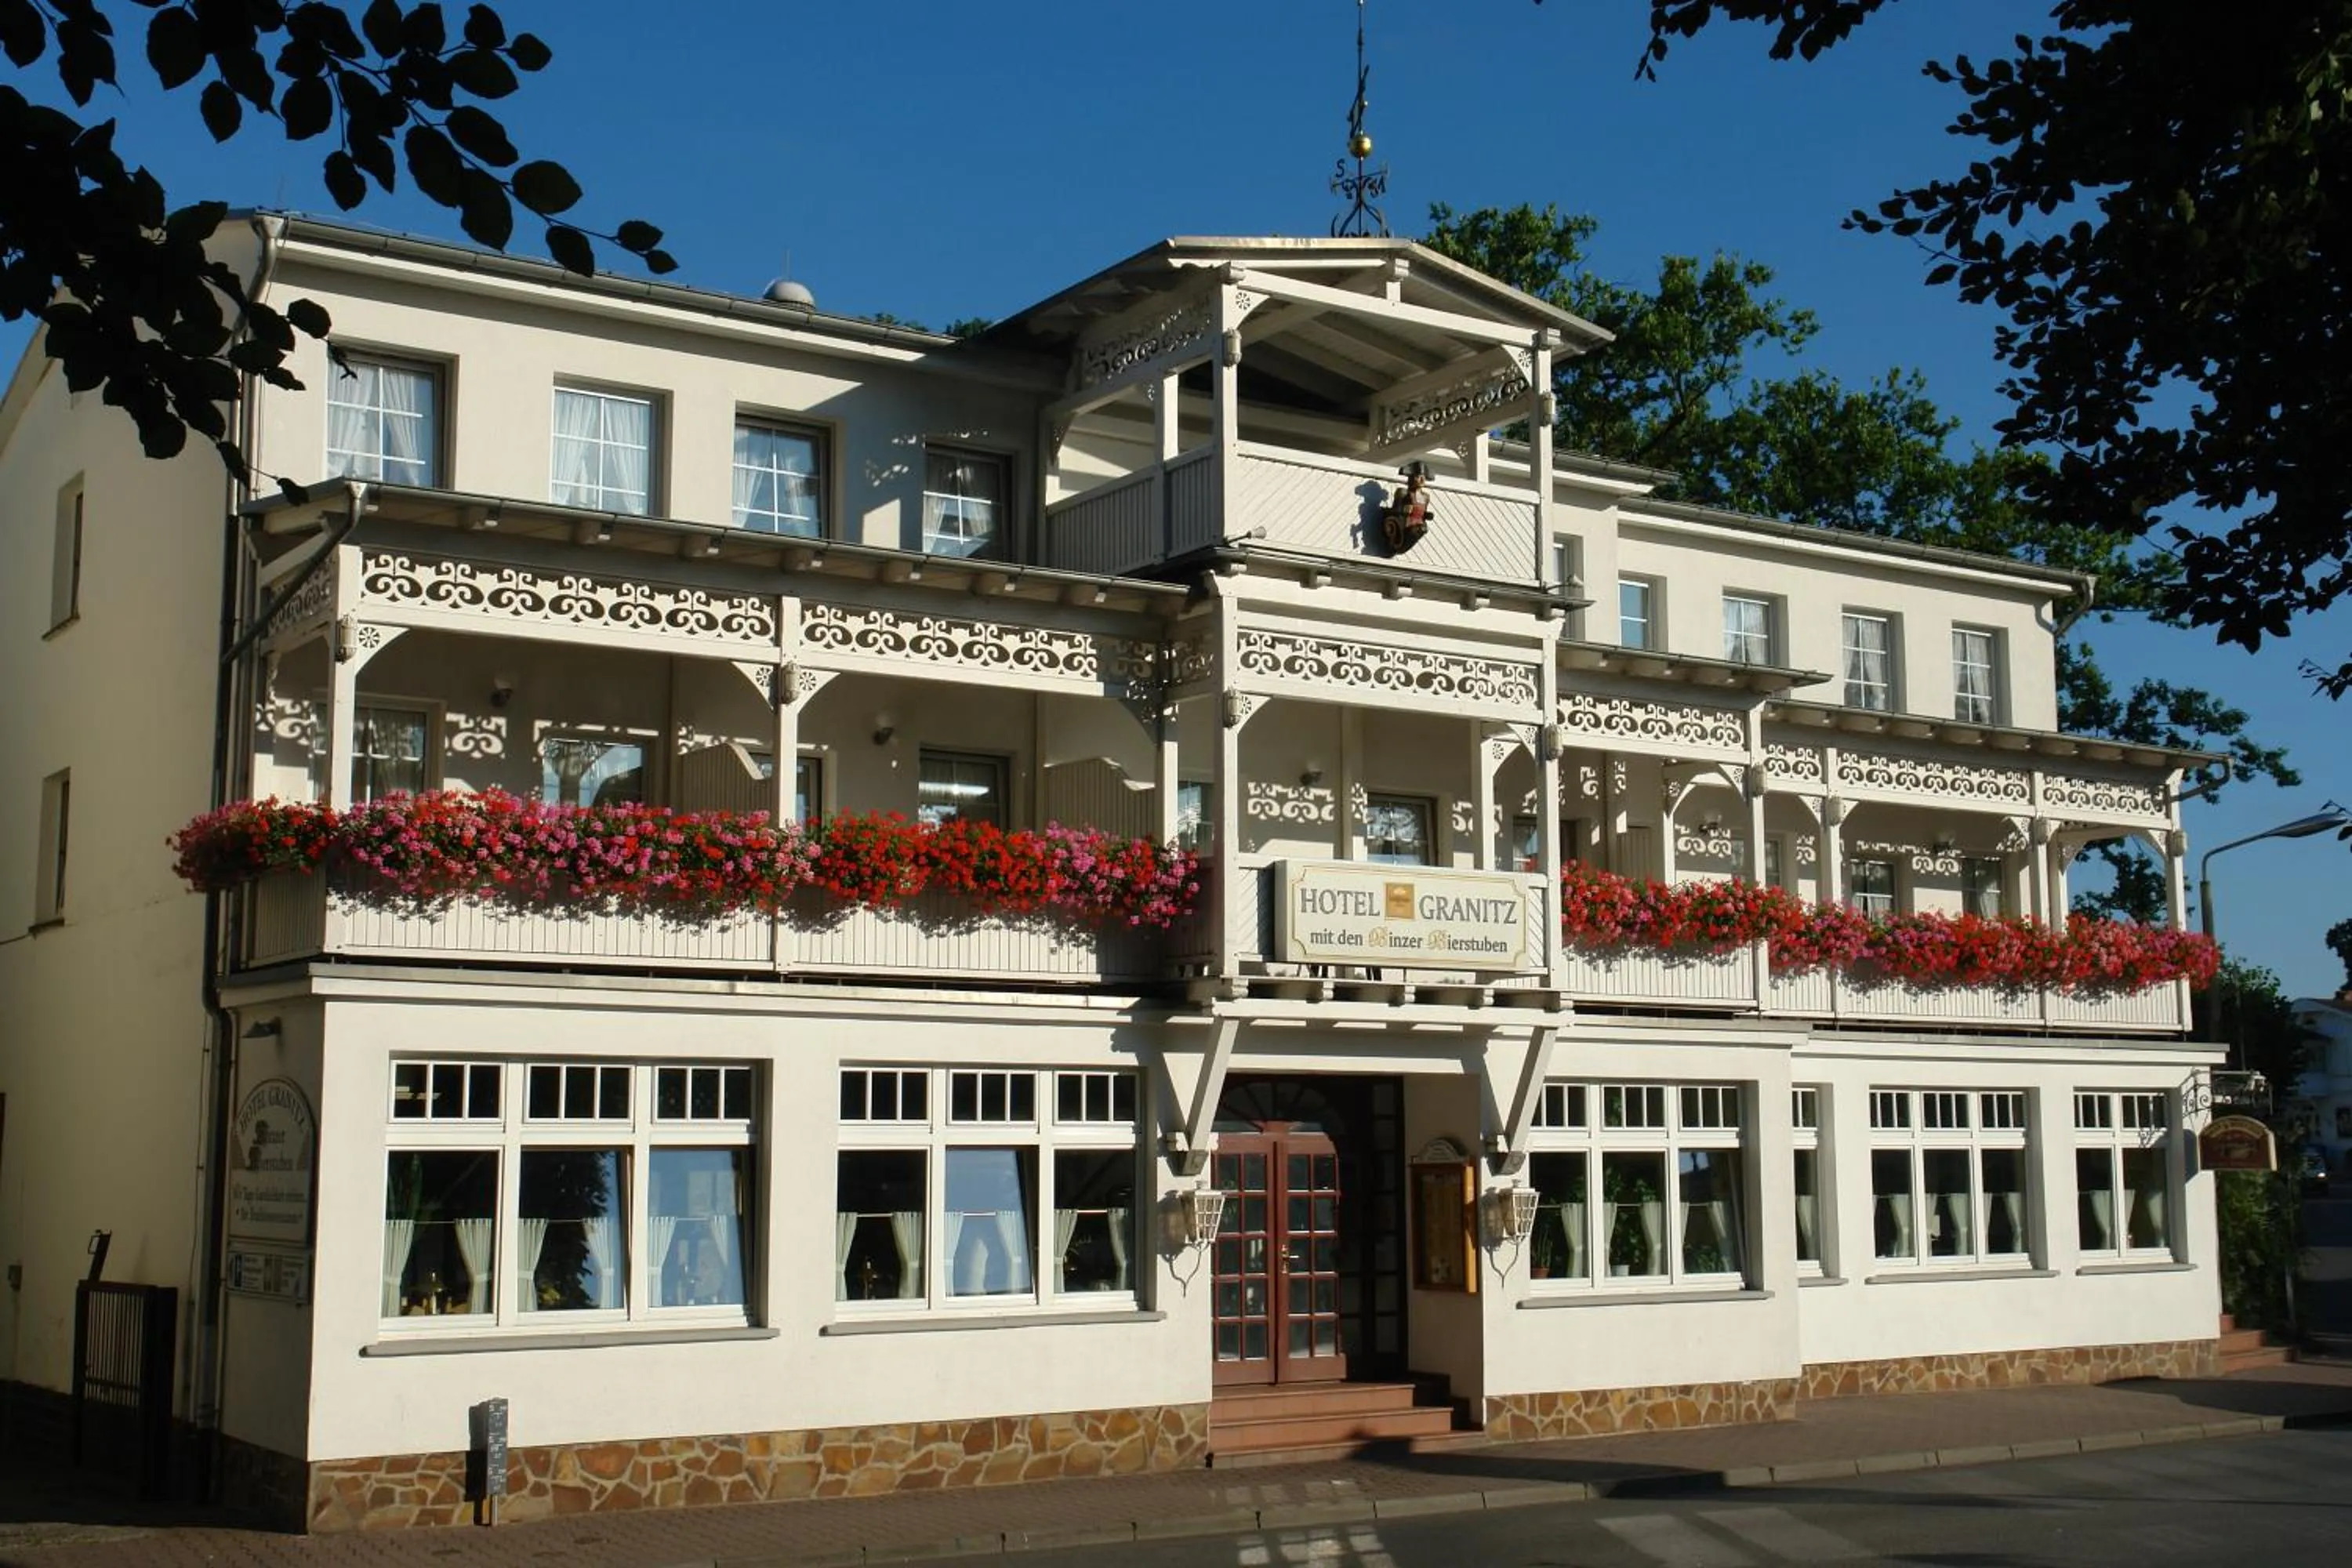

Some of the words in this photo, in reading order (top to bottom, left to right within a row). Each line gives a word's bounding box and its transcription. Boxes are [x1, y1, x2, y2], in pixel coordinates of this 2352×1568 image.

[1301, 887, 1381, 916] HOTEL
[1419, 895, 1518, 924] GRANITZ
[1310, 927, 1334, 945] mit
[1338, 929, 1363, 946] den
[1368, 926, 1423, 948] Binzer
[1428, 929, 1508, 953] Bierstuben
[239, 1090, 266, 1132] HOTEL
